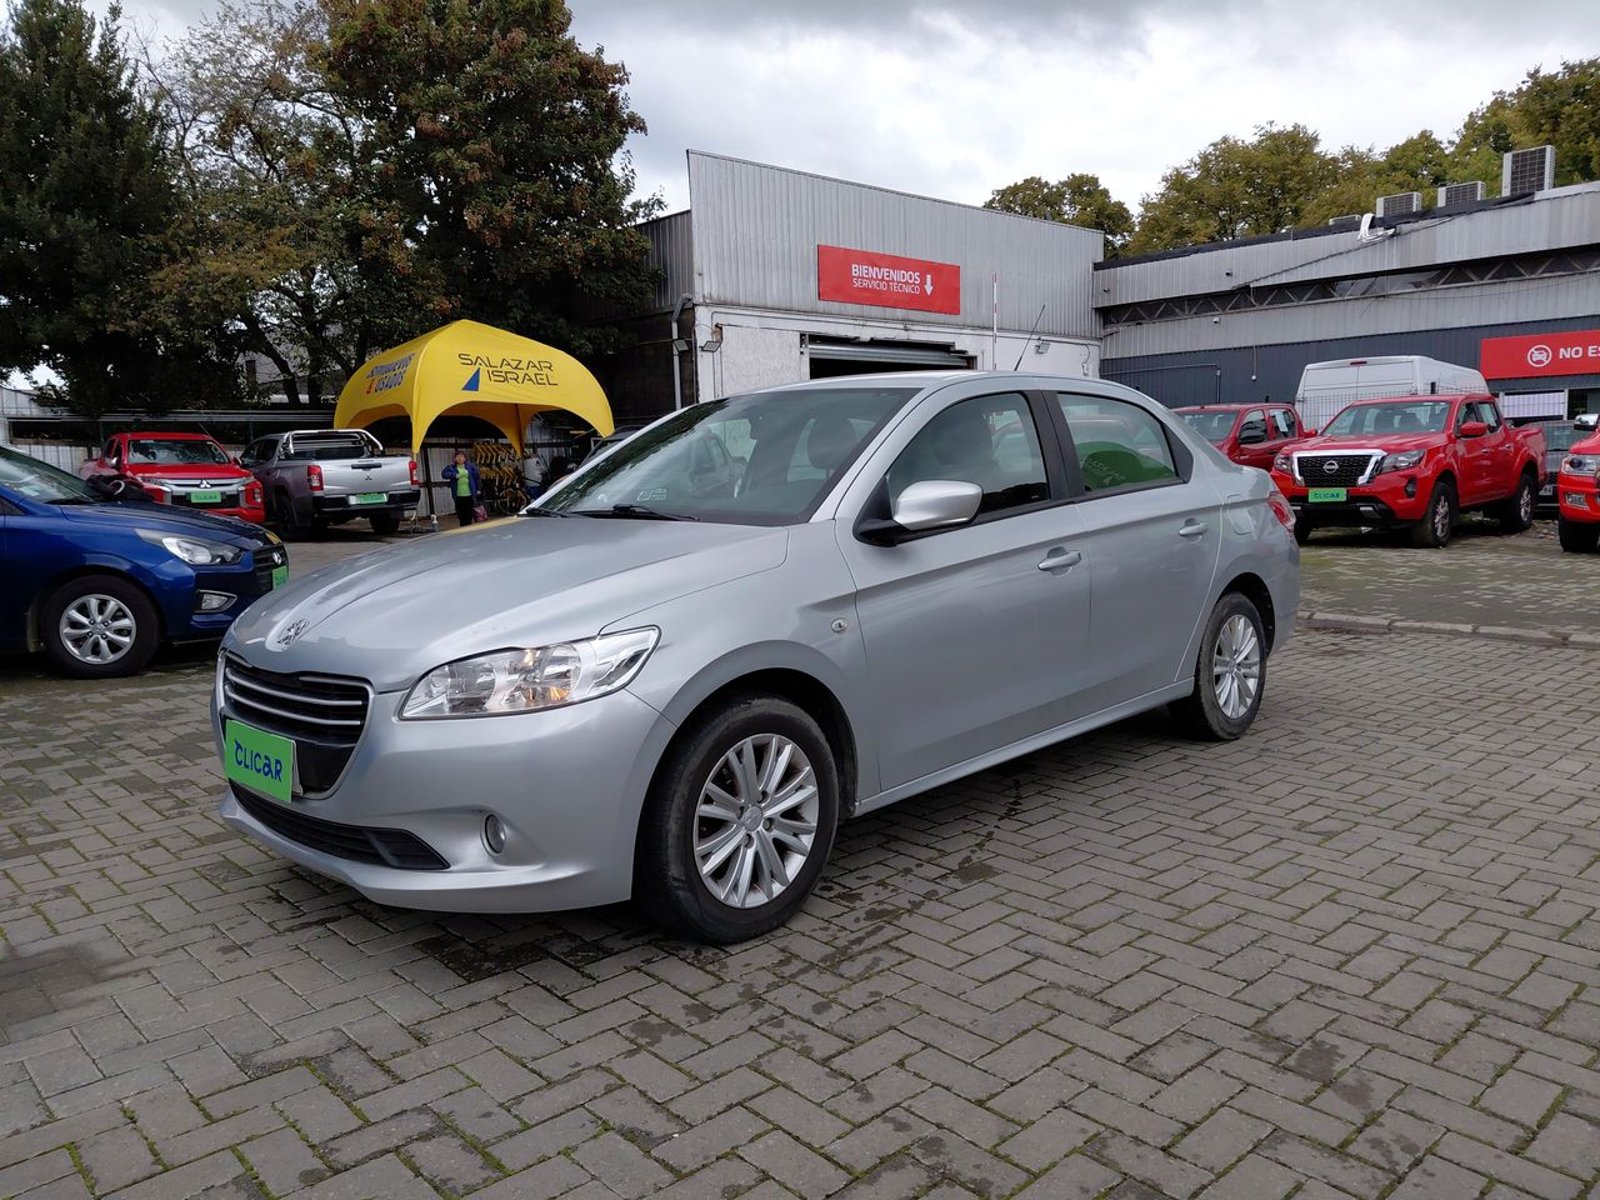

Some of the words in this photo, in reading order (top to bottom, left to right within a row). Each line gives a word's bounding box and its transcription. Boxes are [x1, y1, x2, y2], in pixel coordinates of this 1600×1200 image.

[851, 263, 921, 284] BIENVENIDOS
[853, 278, 888, 291] SERVICIO
[1559, 346, 1583, 359] NO
[458, 353, 554, 372] SALAZAR
[487, 369, 559, 386] ISRAEL
